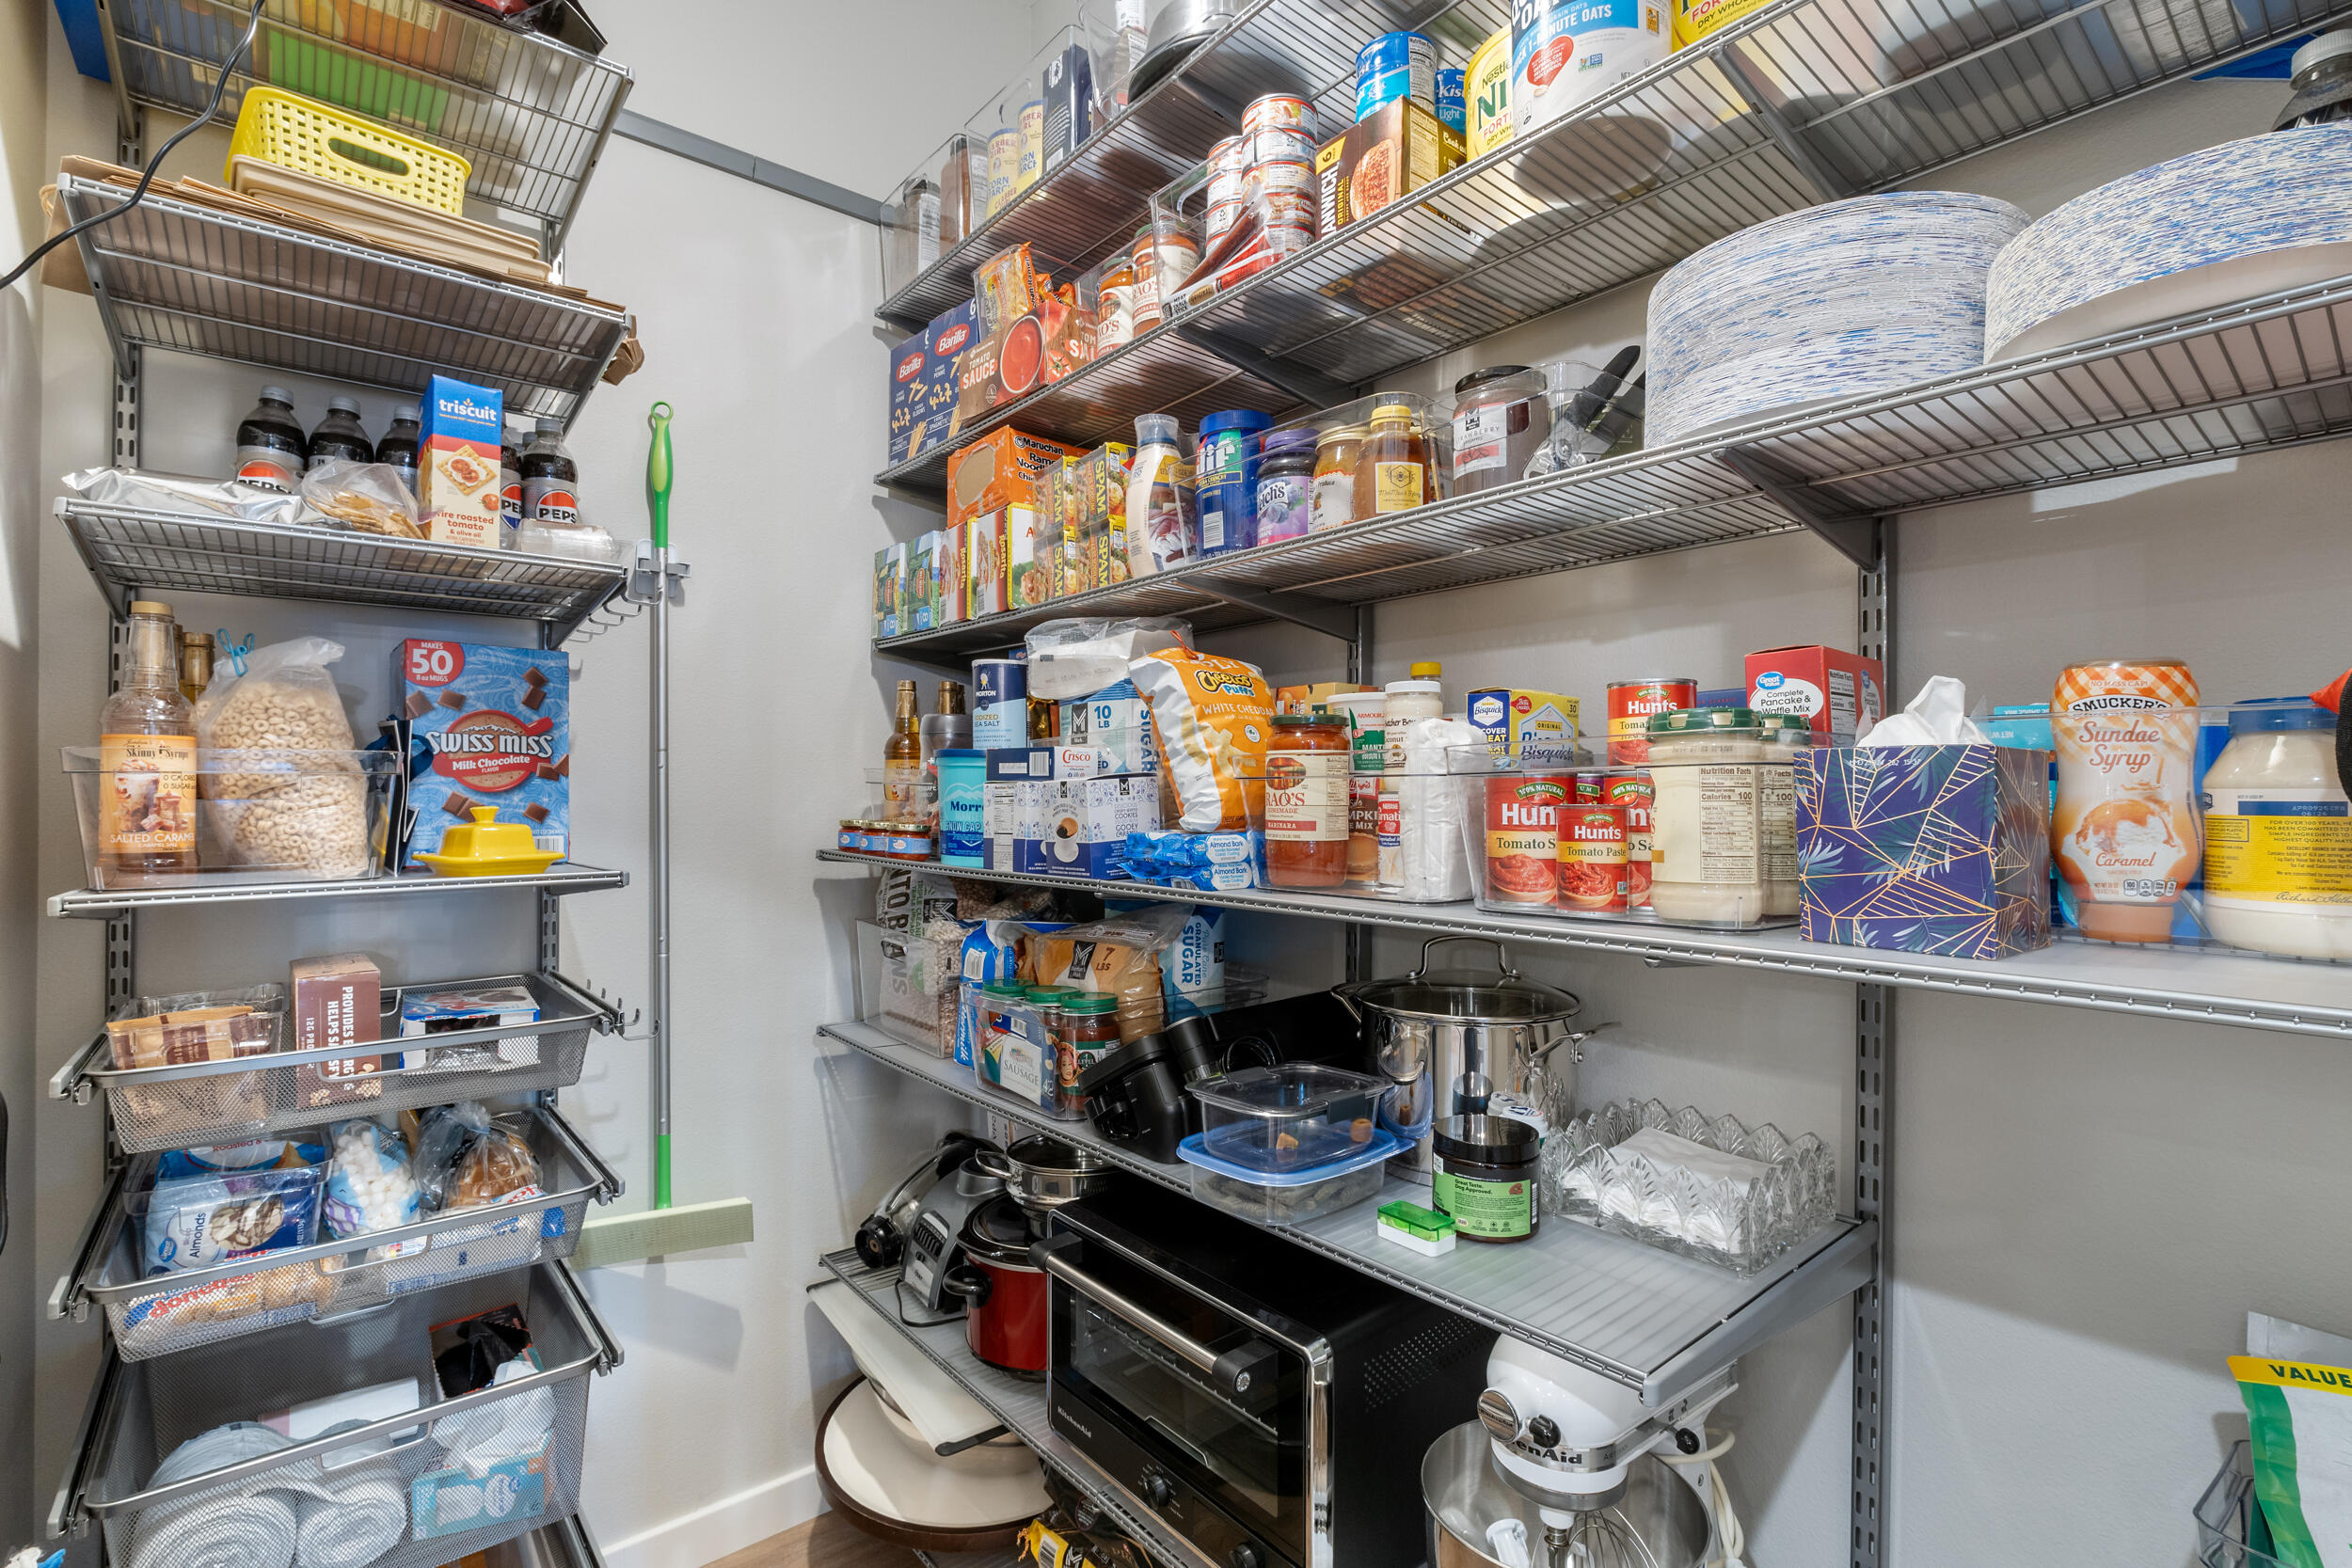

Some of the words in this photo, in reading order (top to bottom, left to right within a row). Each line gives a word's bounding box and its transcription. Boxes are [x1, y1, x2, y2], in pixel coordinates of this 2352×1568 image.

[1581, 5, 1613, 23] OATS
[1698, 12, 1717, 29] DRY
[1439, 108, 1460, 120] Light
[1486, 134, 1499, 146] DRY
[1323, 151, 1331, 162] 6
[969, 298, 977, 316] 6
[938, 328, 967, 352] Barilla
[898, 356, 922, 379] Barilla
[969, 351, 991, 370] TOMATO
[962, 357, 995, 389] SAUCE
[438, 399, 497, 421] triscuit
[1023, 436, 1064, 454] Maruchan
[1096, 460, 1106, 514] SPAM
[1054, 472, 1062, 523] SPAM
[447, 519, 484, 531] tomato
[456, 512, 494, 524] roasted
[999, 534, 1008, 579] Rosarita
[1099, 535, 1108, 587] SPAM
[1055, 546, 1063, 597] SPAM
[411, 649, 453, 675] 50
[1196, 671, 1253, 692] Cheetos
[1759, 675, 1780, 685] Great
[1223, 685, 1255, 697] Puffs
[1766, 689, 1804, 699] Complete
[1569, 705, 1577, 713] 30
[1760, 696, 1802, 706] Pancake
[1094, 705, 1112, 719] 10
[1202, 703, 1236, 715] WHITE
[1236, 705, 1274, 717] CHEDDAR
[1474, 705, 1502, 715] Bisquick
[1619, 721, 1645, 730] Toma
[2078, 720, 2161, 743] Sundae
[425, 730, 496, 754] SWISS
[1140, 709, 1154, 772] SUGAR
[453, 760, 476, 771] Milk
[478, 755, 531, 768] Chocolate
[2089, 744, 2151, 773] Syrup
[1518, 786, 1535, 797] 100%
[1535, 784, 1564, 797] NATURAL
[1613, 786, 1626, 797] 100%
[1266, 792, 1305, 807] RAO'S
[1502, 803, 1556, 826] Hun
[964, 822, 980, 832] CAP
[110, 833, 151, 844] SALTED
[1497, 837, 1546, 849] Tomato
[1566, 847, 1603, 857] Tomato
[1606, 847, 1626, 857] Paste
[2095, 851, 2156, 867] Caramel
[1104, 947, 1115, 961] 7
[1183, 925, 1194, 984] SUGAR
[1096, 962, 1111, 971] LBS
[327, 1001, 339, 1035] HELPS
[342, 986, 354, 1038] PROVIDES
[1003, 1060, 1039, 1085] SAUSAGE
[213, 1140, 254, 1152] Roasted
[190, 1212, 206, 1259] Almonds
[1057, 1405, 1092, 1438] KitchenAid
